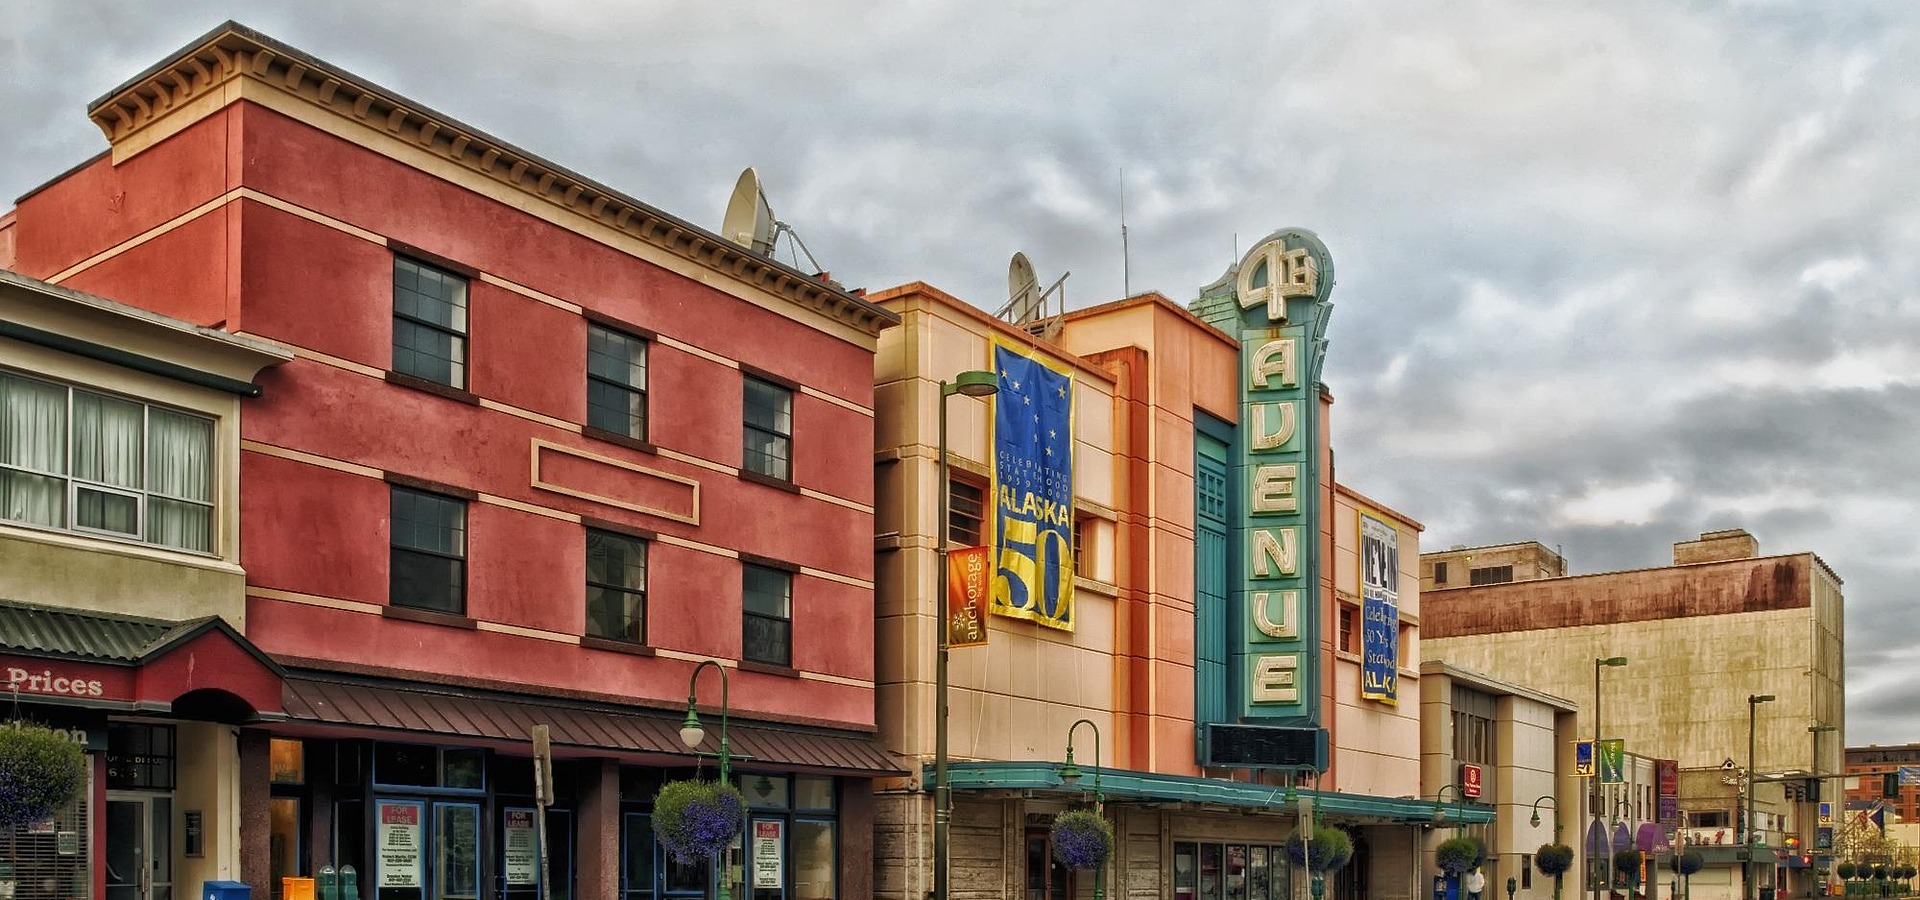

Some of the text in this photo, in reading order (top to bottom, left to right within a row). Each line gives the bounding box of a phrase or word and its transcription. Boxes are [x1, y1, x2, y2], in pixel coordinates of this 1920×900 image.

[1000, 484, 1070, 527] ALASKA
[1251, 339, 1298, 702] AVENUE
[995, 516, 1073, 620] 50
[963, 553, 982, 640] anchorage
[7, 667, 104, 697] Prices
[387, 815, 412, 824] LEASE
[391, 806, 408, 815] FOR
